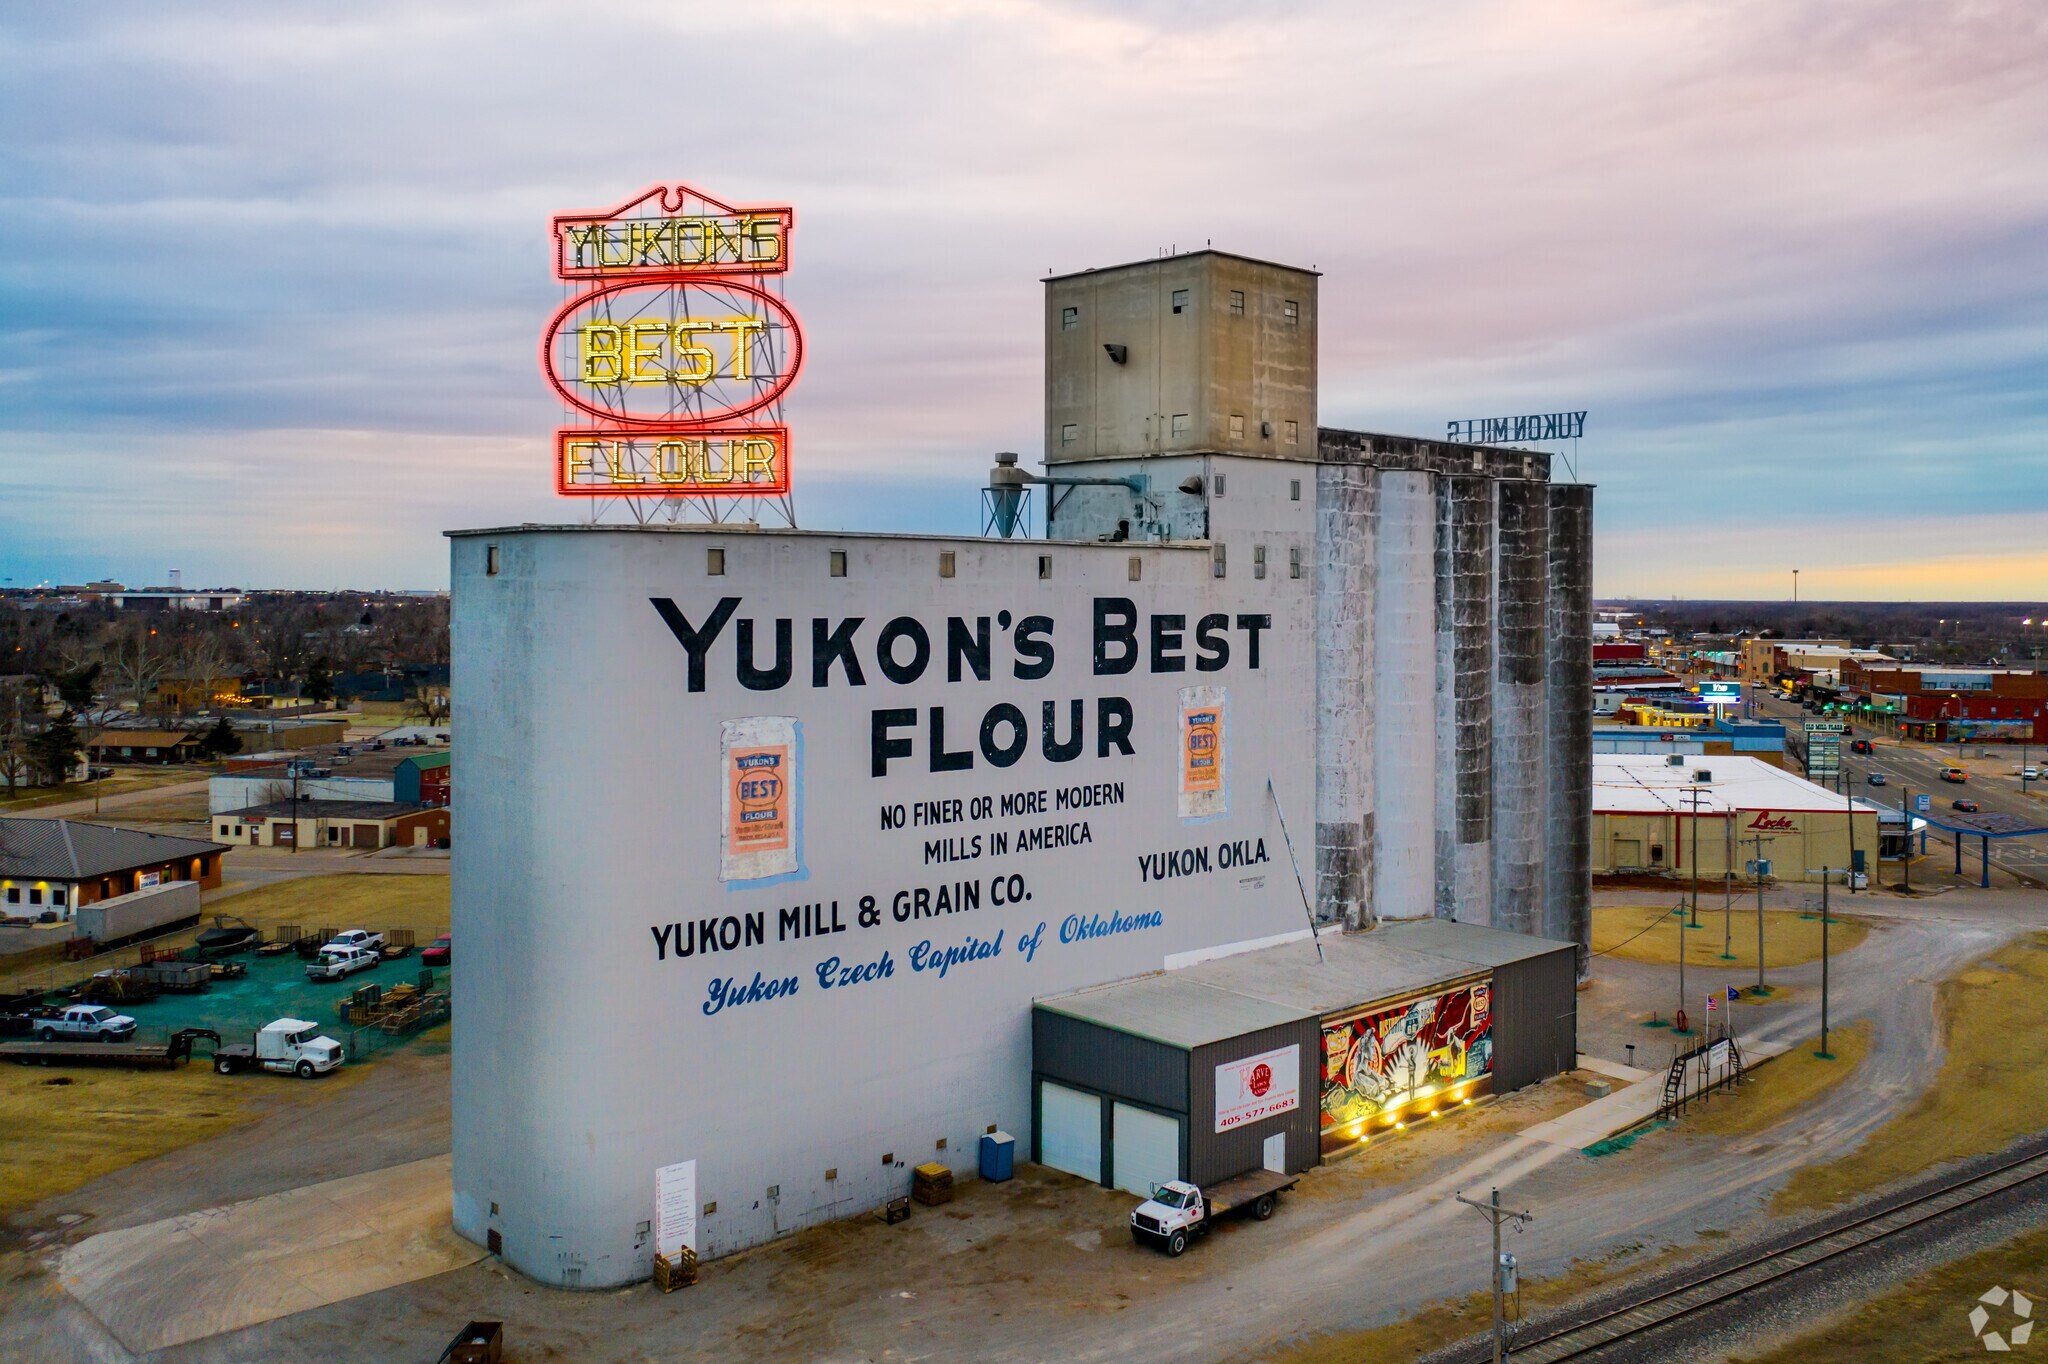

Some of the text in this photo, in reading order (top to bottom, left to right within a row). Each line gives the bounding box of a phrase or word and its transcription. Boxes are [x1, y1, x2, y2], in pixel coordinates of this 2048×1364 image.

[565, 214, 781, 268] YUKON'S
[584, 321, 763, 383] BEST
[567, 439, 776, 484] FLOUR
[649, 597, 1271, 692] YUKON'S BEST
[872, 697, 1135, 777] FLOUR
[1191, 734, 1214, 749] BEST
[743, 757, 775, 766] YUKON'S
[741, 779, 778, 800] BEST
[881, 782, 1124, 830] NO FINER OR MORE MODERN
[745, 810, 774, 820] FLOUR
[1747, 811, 1792, 829] Locke
[925, 822, 1092, 864] MILLS IN AMERICA
[1138, 838, 1270, 882] YUKON, OKLA.
[651, 874, 1032, 960] YUKON MILL & GRAIN CO.
[702, 909, 1163, 1016] Yukon Czech Capital of Oklahoma
[1220, 1098, 1295, 1127] 405-577-6683
